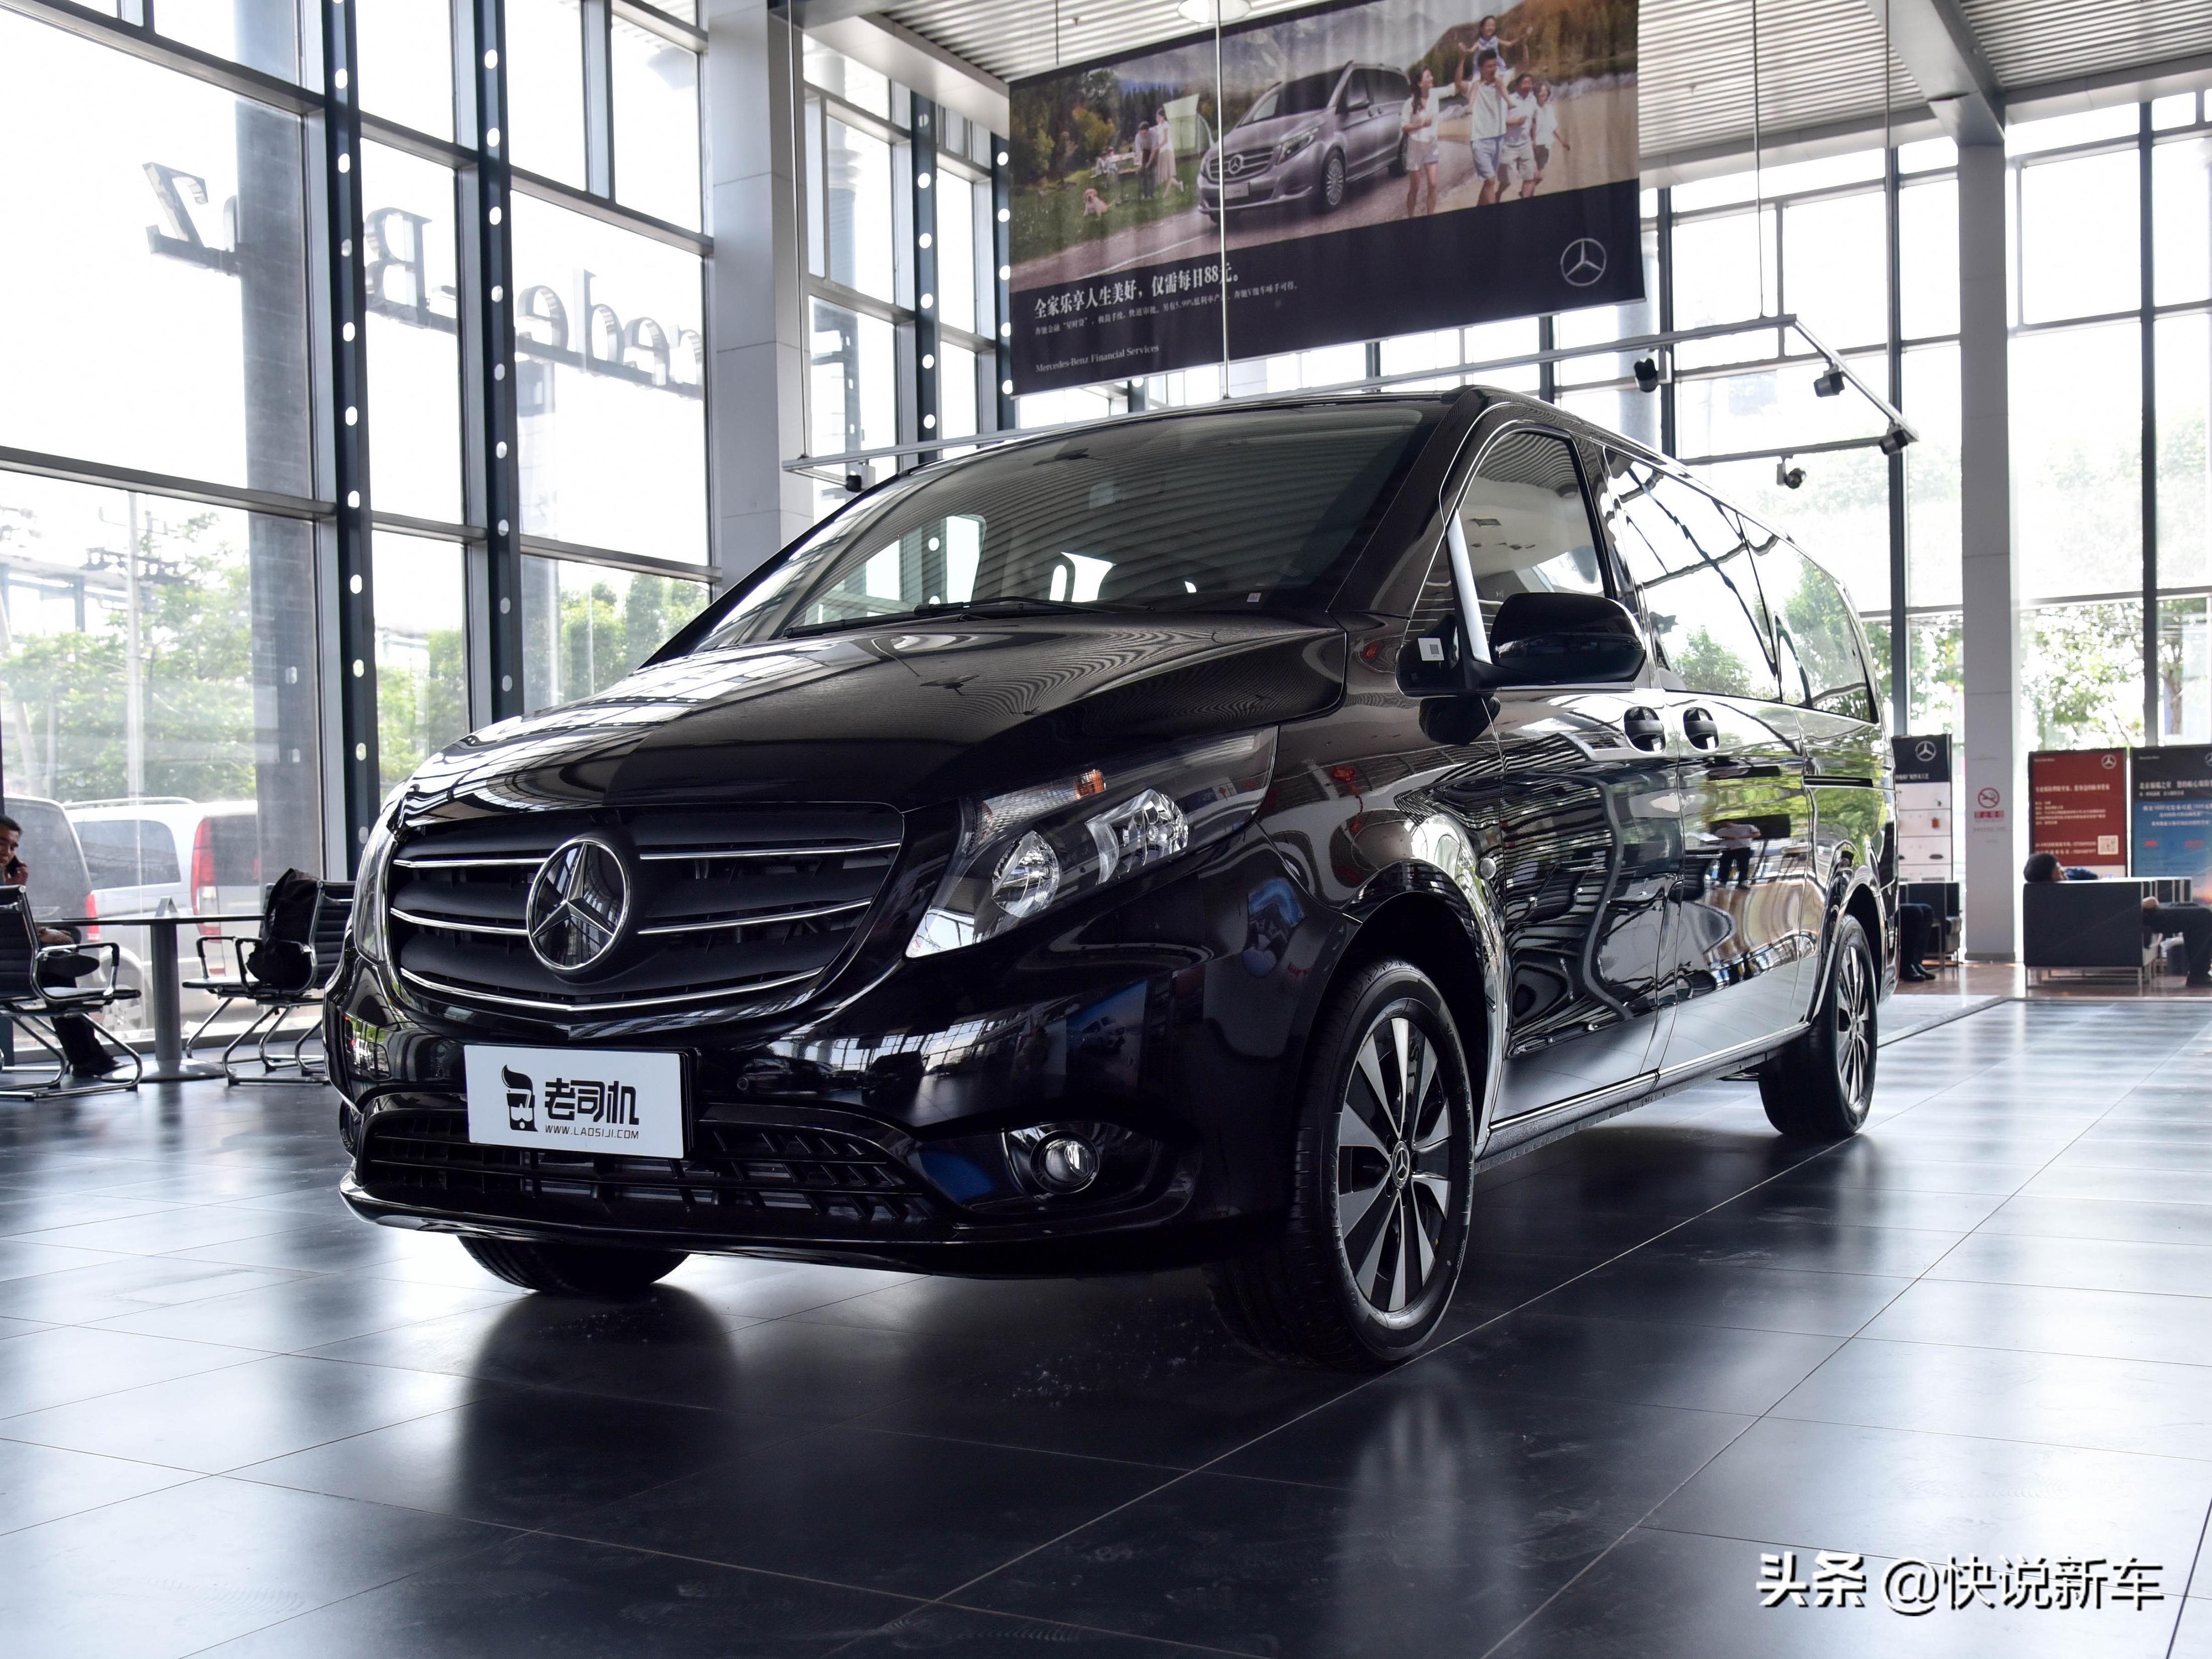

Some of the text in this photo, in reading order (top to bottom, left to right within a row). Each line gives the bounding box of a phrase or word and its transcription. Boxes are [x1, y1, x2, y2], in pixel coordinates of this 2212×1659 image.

[1036, 345, 1159, 373] Mercedes-Benz Financial Services
[544, 1077, 639, 1125] 老司机
[545, 1125, 639, 1140] WWW.LAOSIJI.COM
